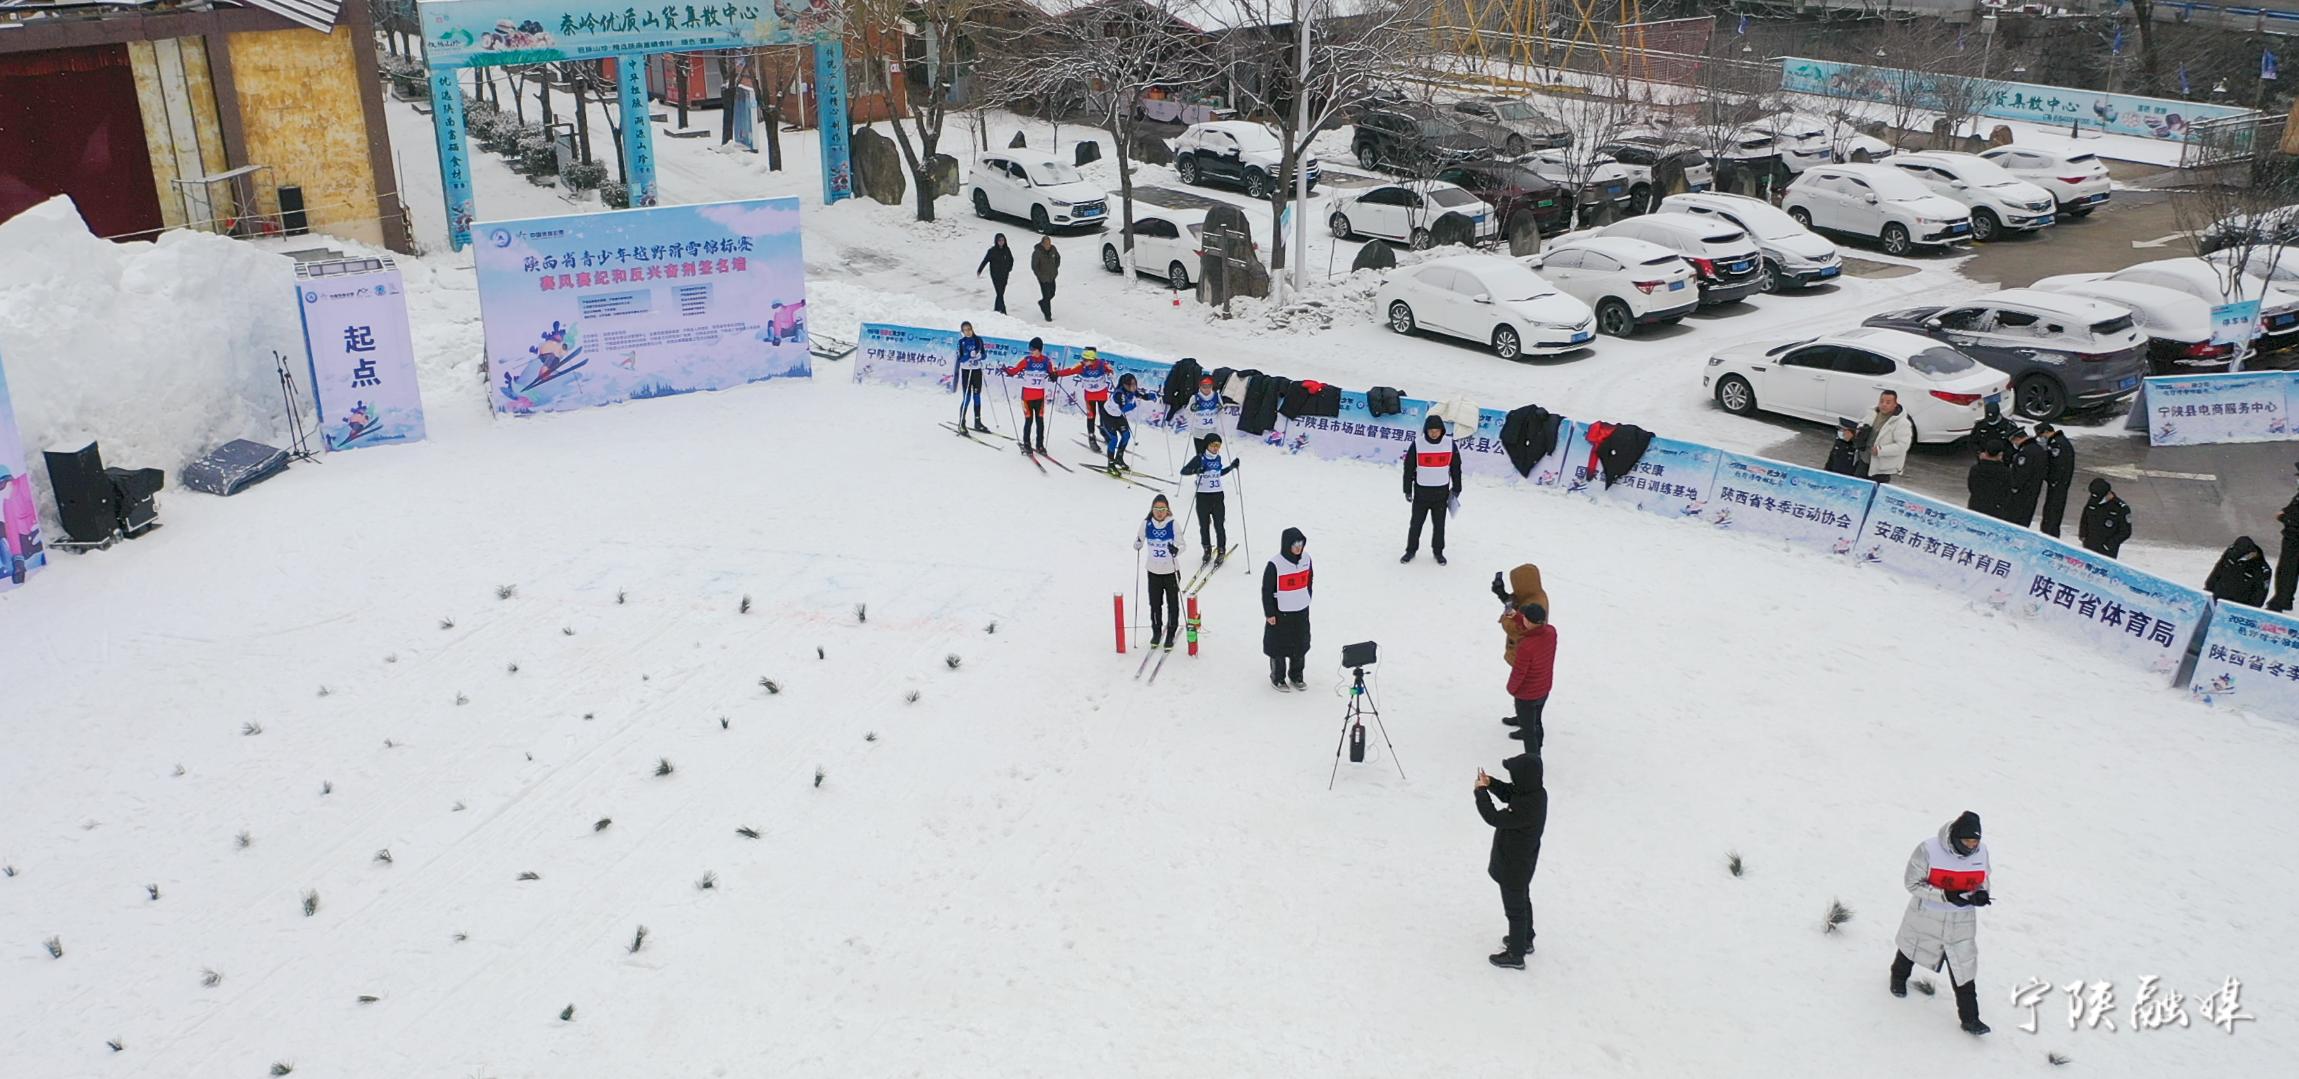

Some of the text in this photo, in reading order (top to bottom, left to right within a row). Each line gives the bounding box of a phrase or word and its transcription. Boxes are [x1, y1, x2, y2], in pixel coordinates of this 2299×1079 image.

[560, 3, 759, 37] 秦岭优质山货集散中心
[524, 236, 753, 272] 陕西省青少年越野滑雪锦标赛
[539, 256, 747, 292] 赛风赛纪和反兴奋剂签名墙
[344, 325, 381, 388] 起点
[2159, 401, 2278, 418] 宁陕县电商服务中心
[1295, 416, 1417, 442] 宁陕县市场监督管理局
[1209, 480, 1220, 488] 33
[1720, 486, 1852, 529] 陕西省冬季运动协会
[1153, 549, 1166, 558] 32
[1874, 520, 2011, 579] 安康市教育体育局
[2029, 574, 2176, 648] 陕西省体育局
